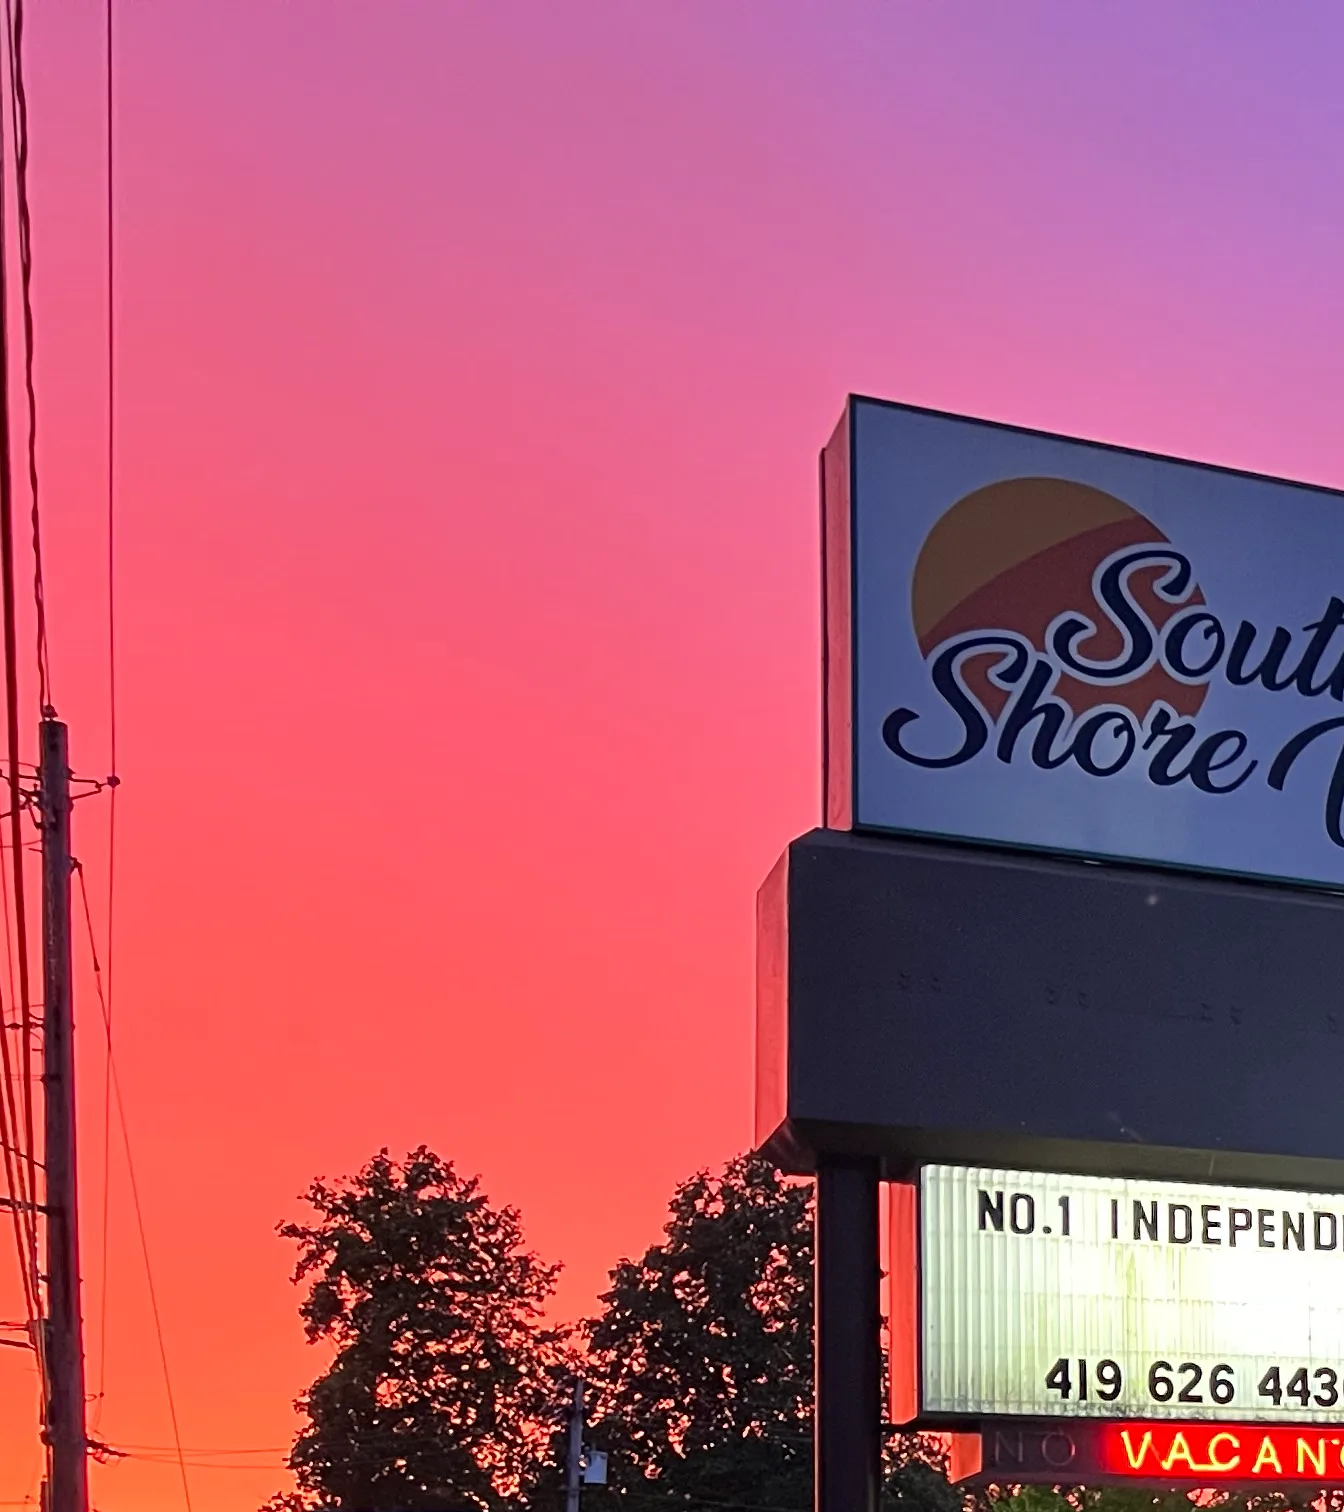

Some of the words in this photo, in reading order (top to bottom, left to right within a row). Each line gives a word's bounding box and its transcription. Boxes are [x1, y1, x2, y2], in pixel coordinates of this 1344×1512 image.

[882, 637, 1257, 795] Shore
[977, 1189, 1071, 1236] NO.1
[1044, 1357, 1122, 1402] 419
[1148, 1360, 1235, 1405] 626
